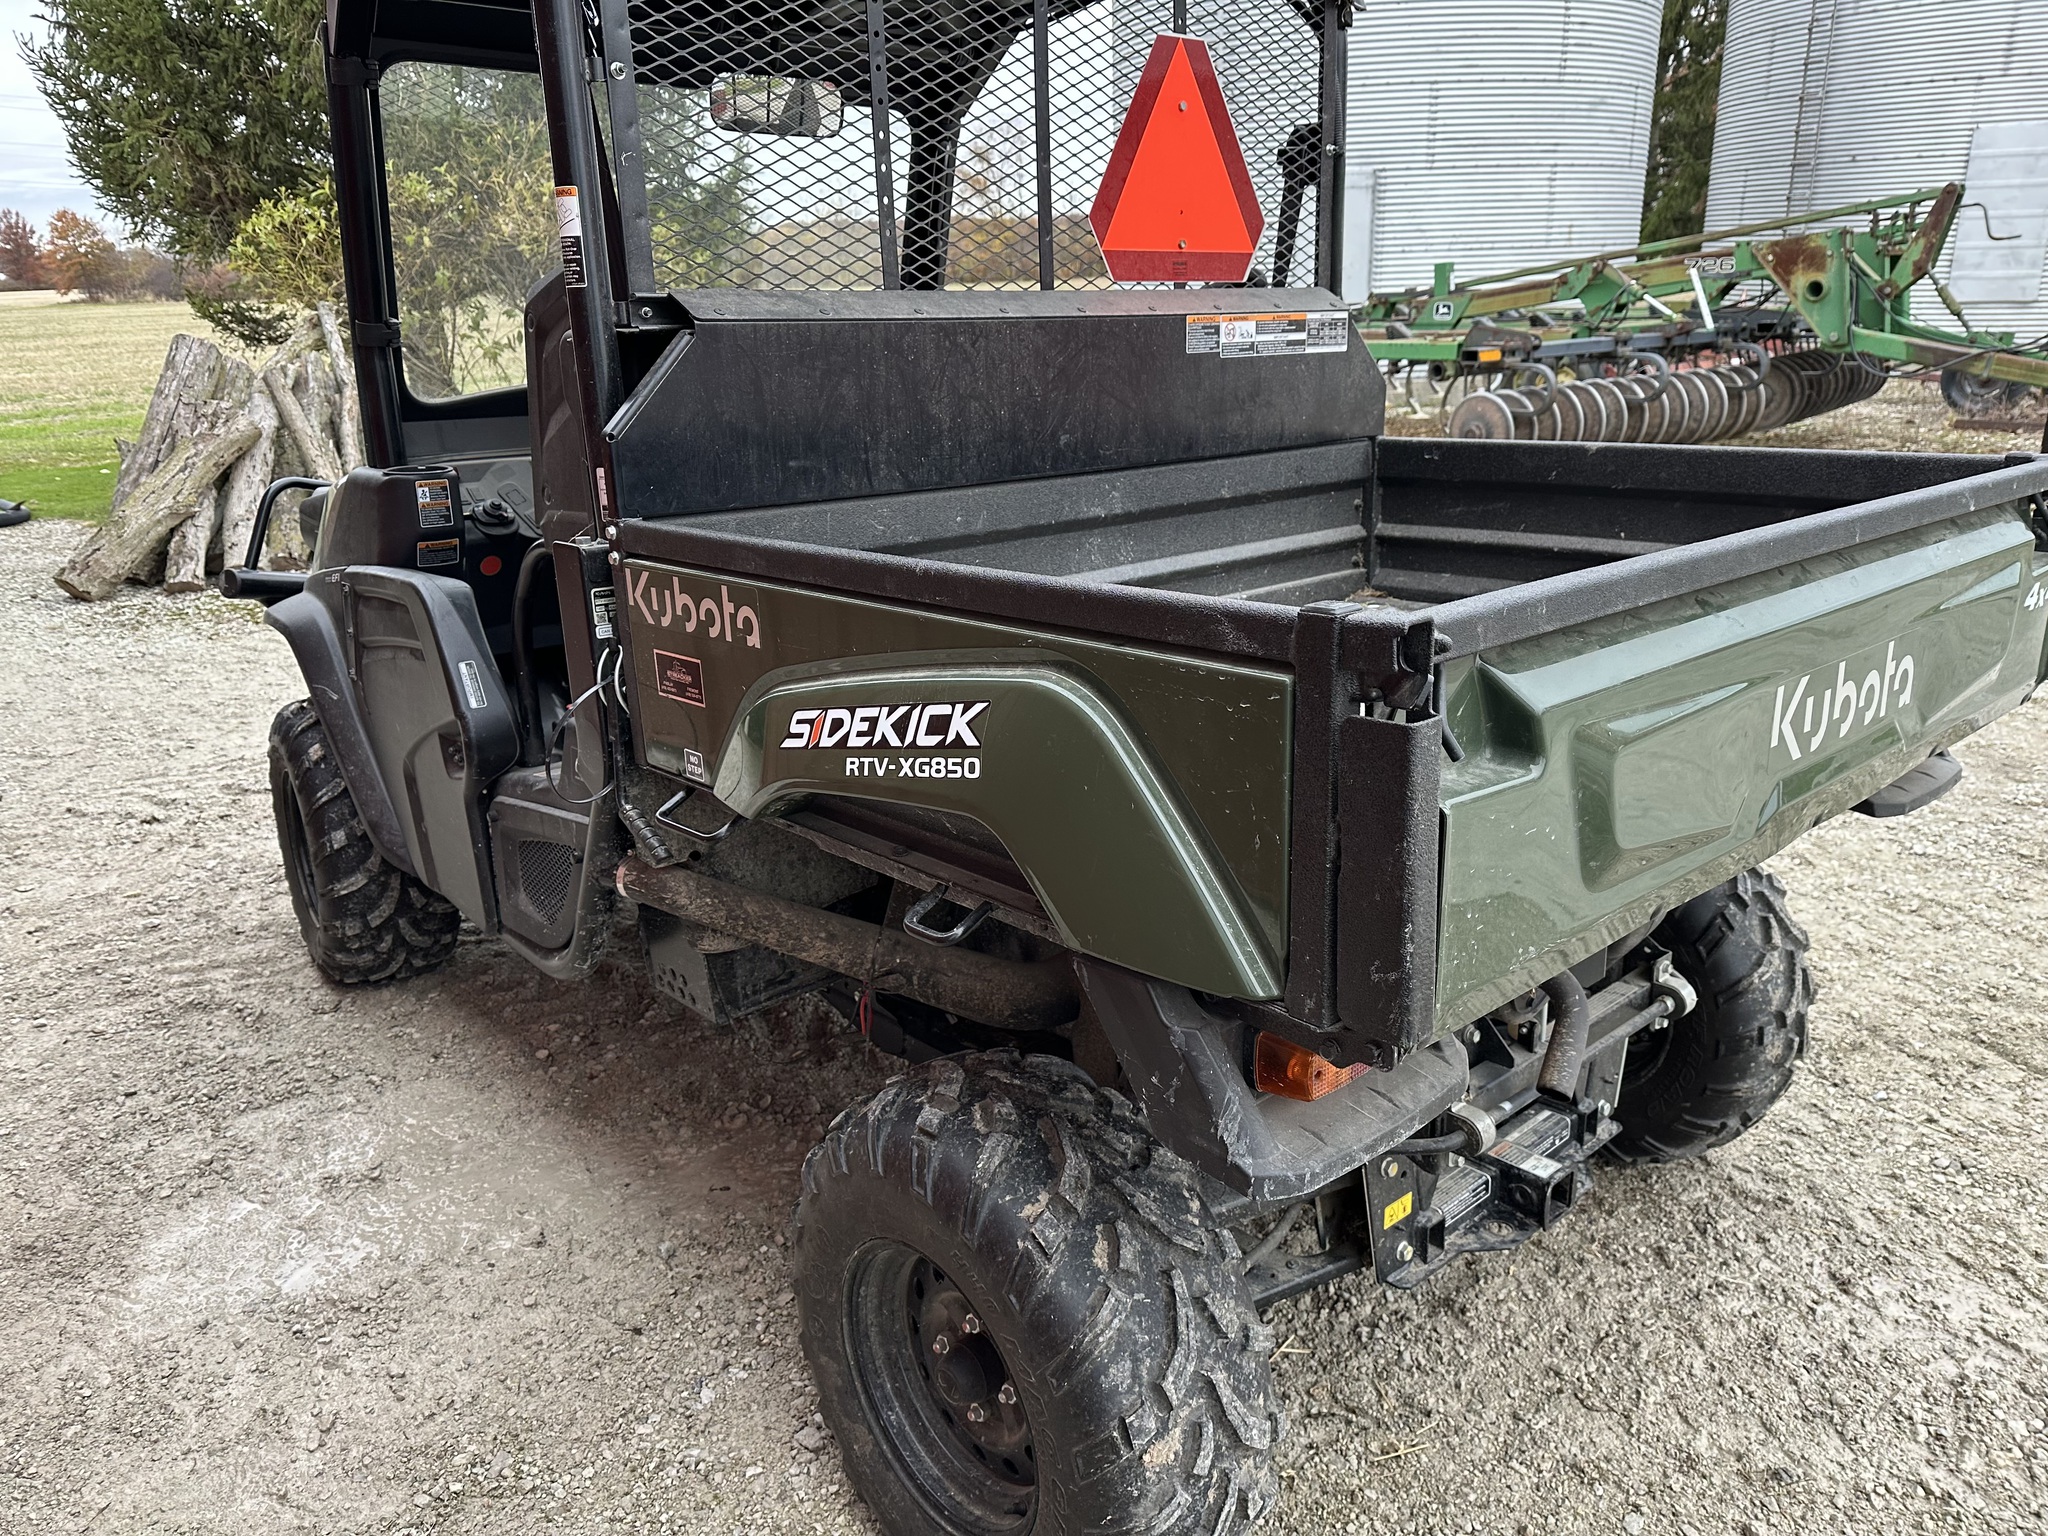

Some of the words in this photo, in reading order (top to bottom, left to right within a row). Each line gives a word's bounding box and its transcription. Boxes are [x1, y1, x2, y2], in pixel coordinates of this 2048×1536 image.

[1683, 256, 1736, 275] 726
[625, 568, 761, 649] Kubota
[1770, 640, 1914, 761] Kubota
[779, 702, 990, 749] SIDEKICK
[688, 764, 702, 775] STEP
[690, 755, 698, 764] NO
[845, 757, 981, 779] RTV-XG850
